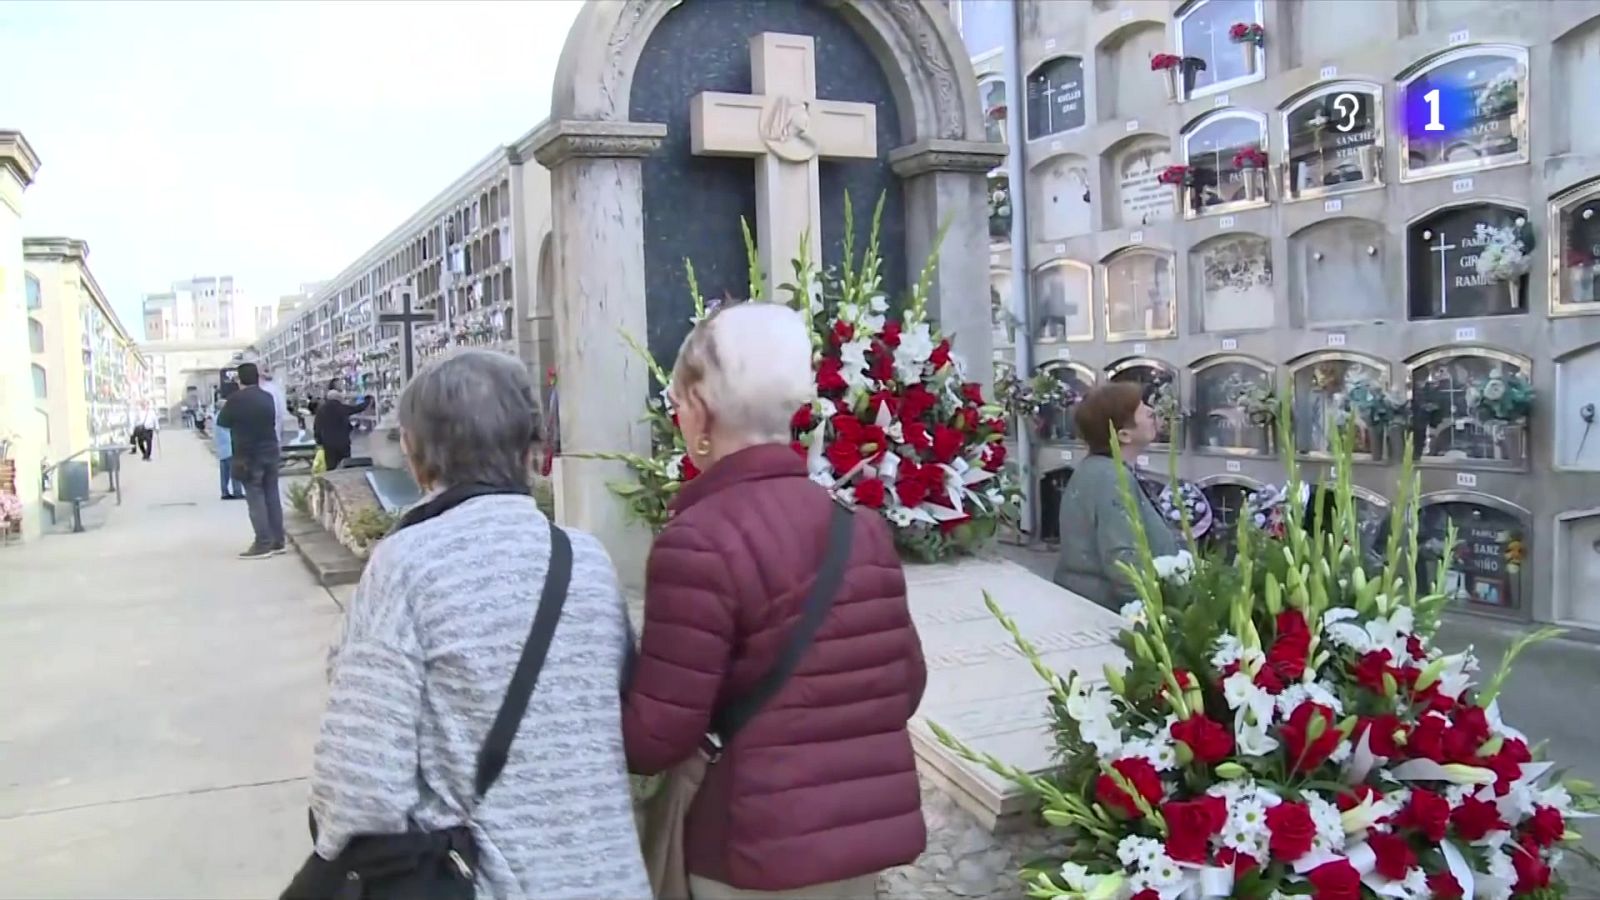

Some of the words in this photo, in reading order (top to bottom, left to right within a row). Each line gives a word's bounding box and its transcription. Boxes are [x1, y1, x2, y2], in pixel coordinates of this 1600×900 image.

[1462, 237, 1493, 248] FAMIL
[1460, 255, 1479, 268] GIR
[1456, 274, 1498, 287] RAMI
